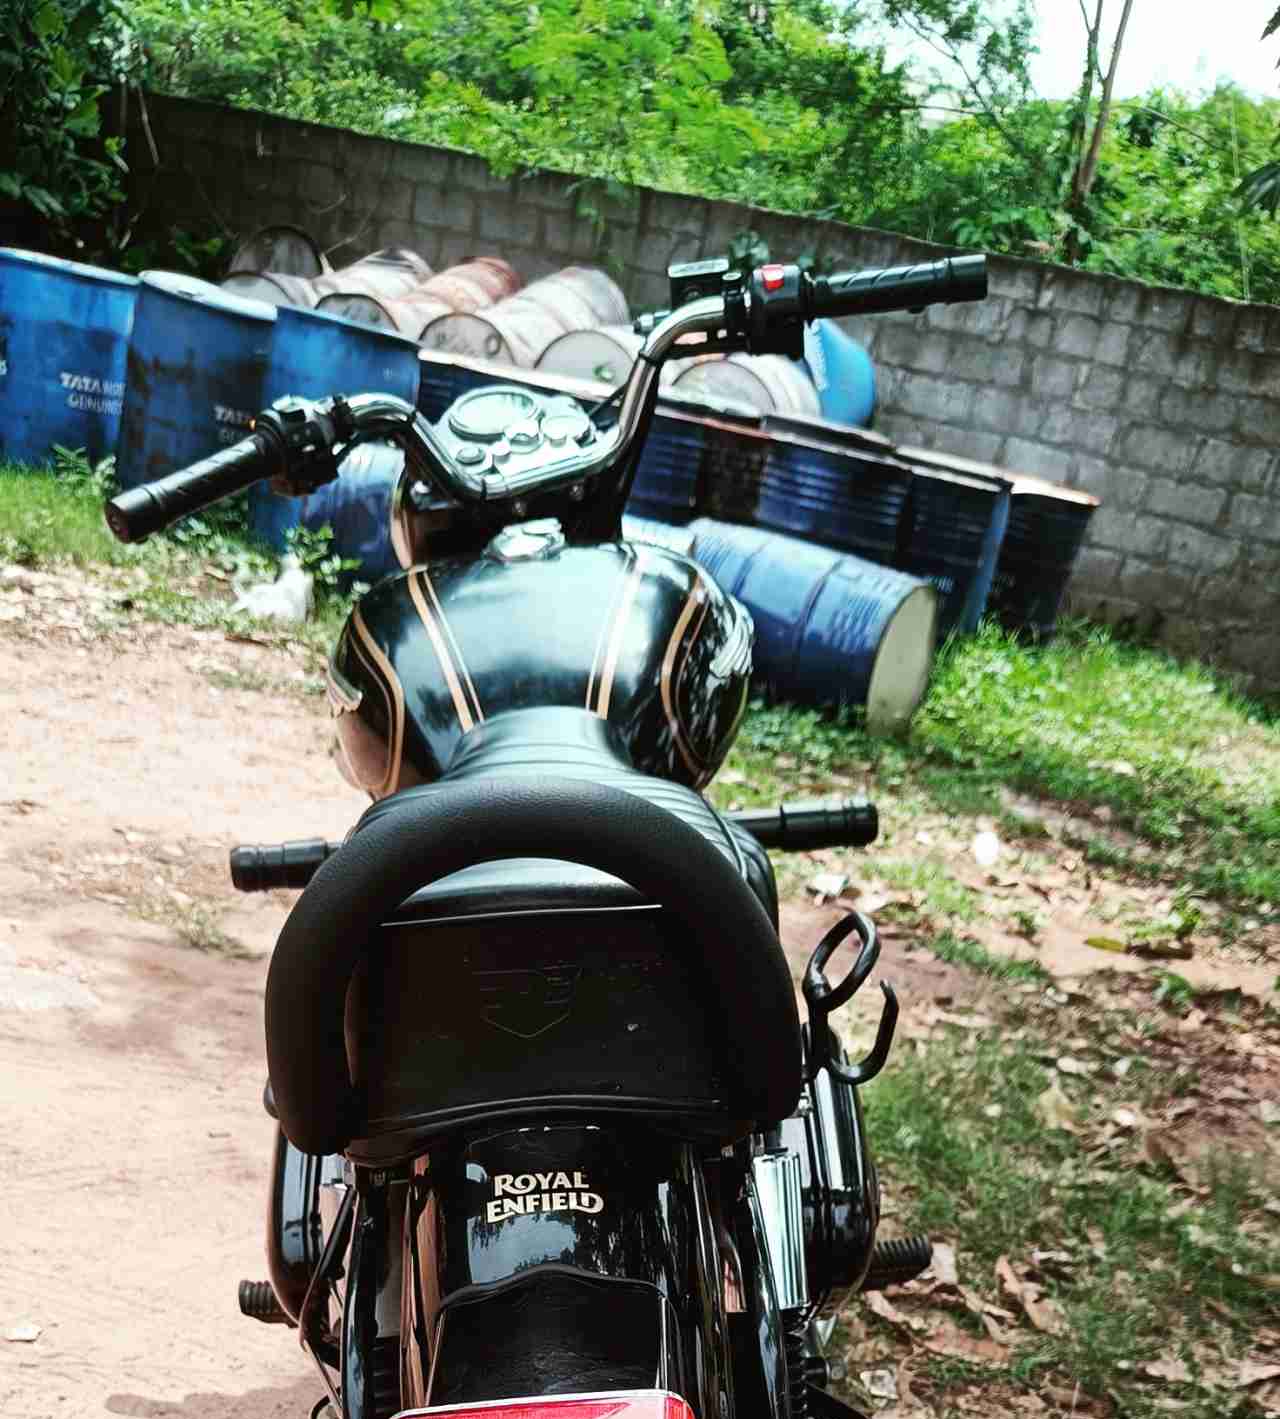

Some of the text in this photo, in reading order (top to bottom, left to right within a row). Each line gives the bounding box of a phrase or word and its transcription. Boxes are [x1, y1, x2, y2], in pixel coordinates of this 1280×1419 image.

[60, 372, 102, 393] TATA
[494, 1171, 589, 1197] ROYAL
[486, 1192, 604, 1223] ENFIELD
